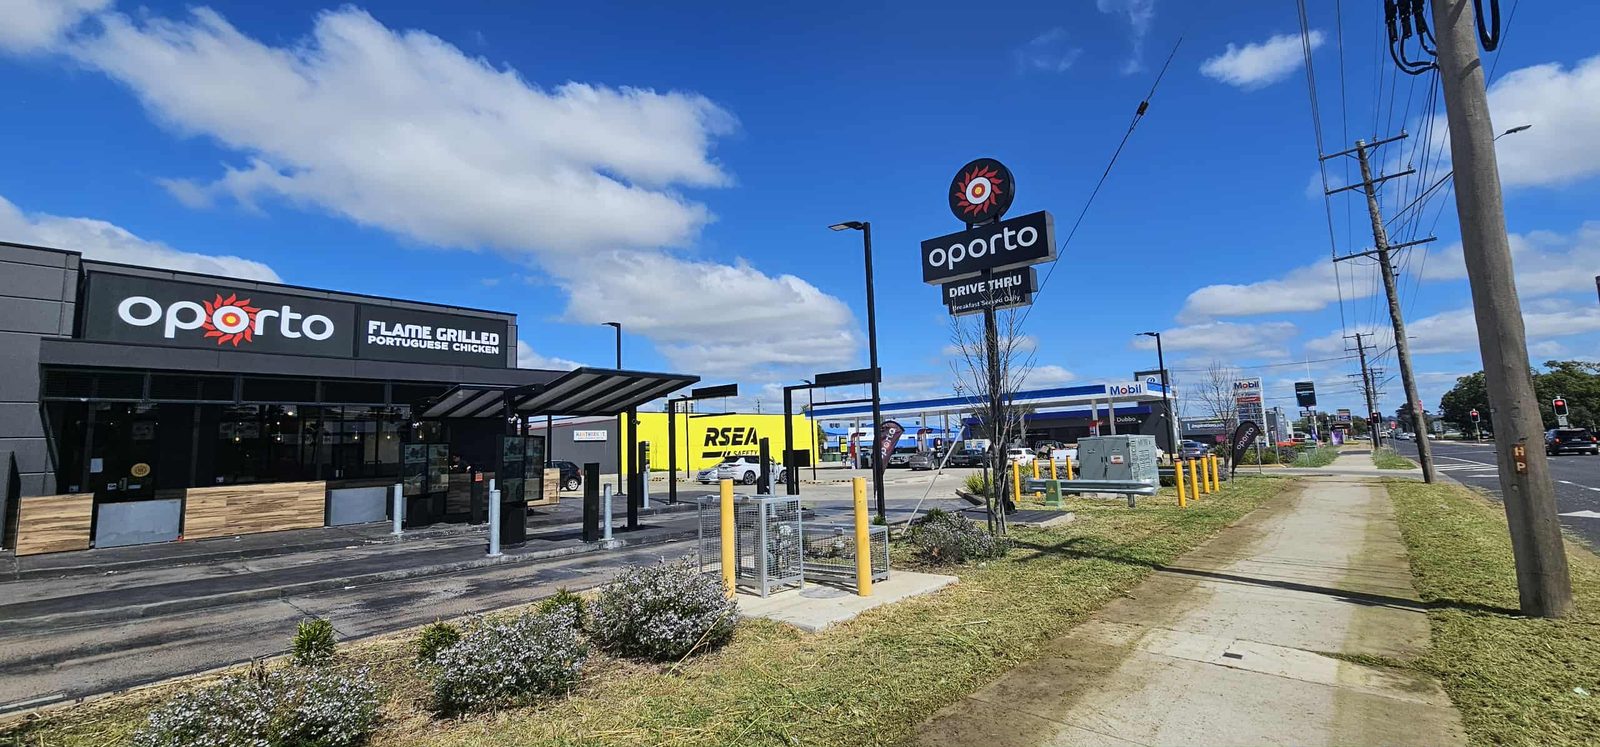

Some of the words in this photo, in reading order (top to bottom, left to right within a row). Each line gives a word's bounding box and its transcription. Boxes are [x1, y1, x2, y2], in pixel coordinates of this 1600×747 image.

[929, 226, 1038, 270] oporto
[949, 282, 986, 298] DRIVE
[988, 274, 1022, 290] THRU
[952, 302, 981, 311] Breakfast
[117, 295, 335, 341] oporto
[367, 319, 432, 340] FLAME
[436, 327, 499, 346] GRILLED
[367, 335, 449, 351] PORTUGUESE
[452, 342, 499, 355] CHICKEN
[1110, 384, 1141, 395] Mobil
[1233, 381, 1259, 389] Mobil
[1116, 415, 1137, 423] Dubbo
[703, 427, 758, 447] RSEA
[881, 427, 896, 460] porto
[1236, 427, 1255, 450] oporto
